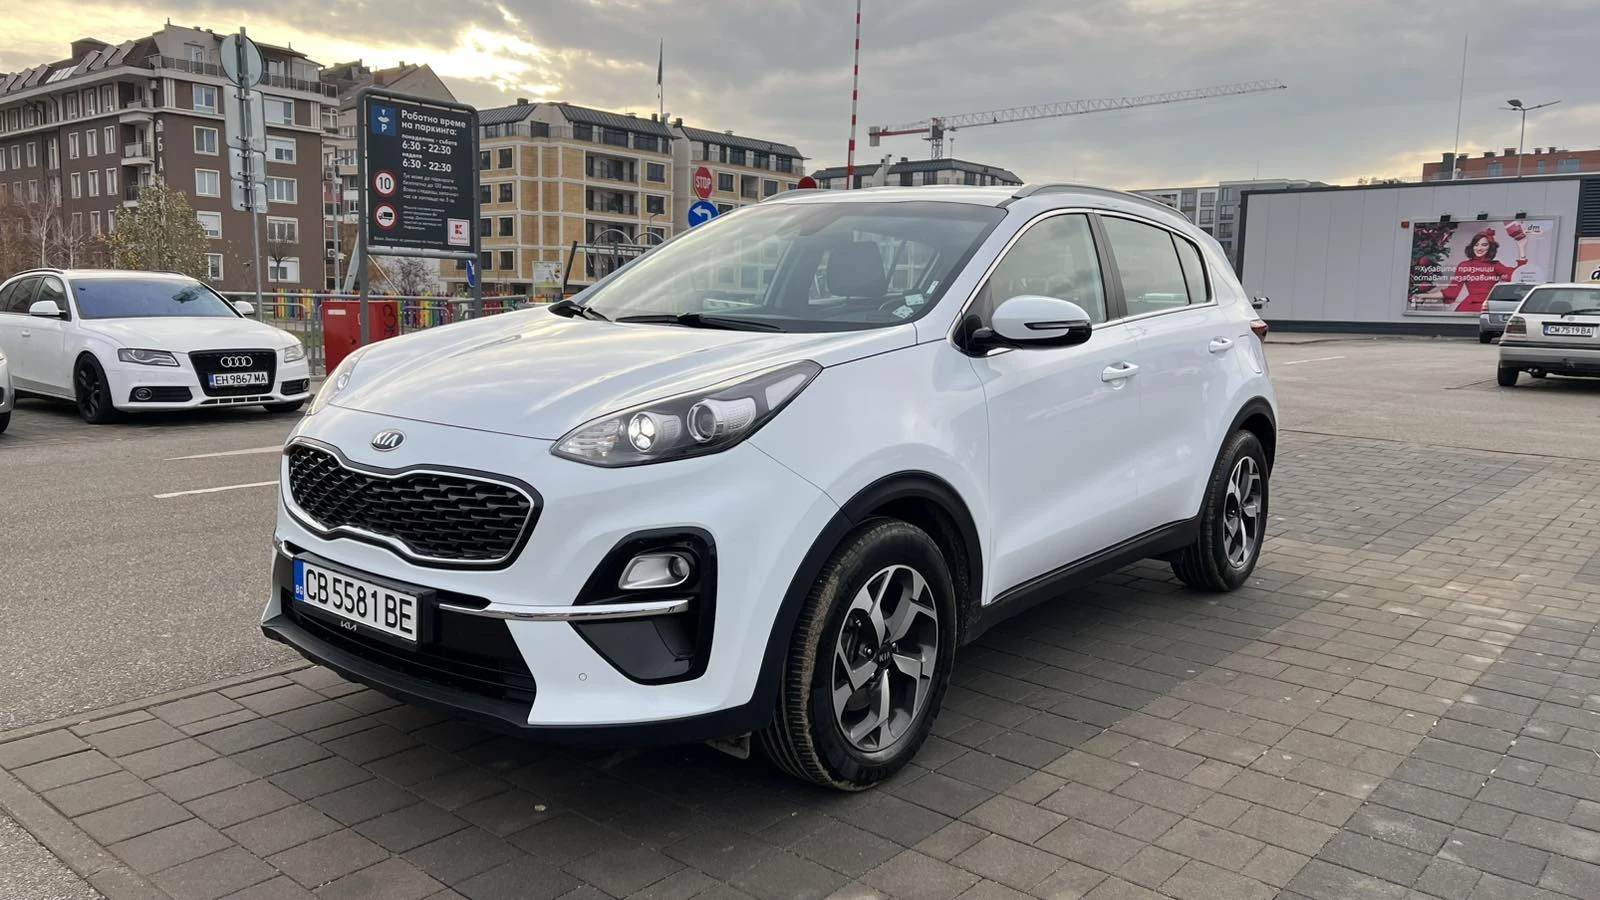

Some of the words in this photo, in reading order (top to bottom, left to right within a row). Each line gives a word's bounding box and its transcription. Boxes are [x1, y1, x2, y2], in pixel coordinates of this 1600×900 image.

[401, 110, 438, 123] Работно
[440, 118, 466, 128] време
[381, 123, 387, 132] P
[415, 124, 457, 136] паркинга:
[402, 140, 421, 151] 6:30
[428, 144, 451, 155] 22:30
[402, 159, 421, 168] 6:30
[428, 161, 452, 172] 22:30
[380, 177, 391, 189] 10
[695, 175, 711, 189] STOP
[1413, 273, 1448, 282] остават
[230, 373, 252, 384] 9867
[373, 432, 399, 447] KIA
[295, 584, 304, 596] BG
[305, 568, 329, 605] CB
[332, 576, 378, 623] 5581
[384, 593, 413, 635] BE
[340, 620, 357, 632] KIA
[879, 652, 890, 662] KIA
